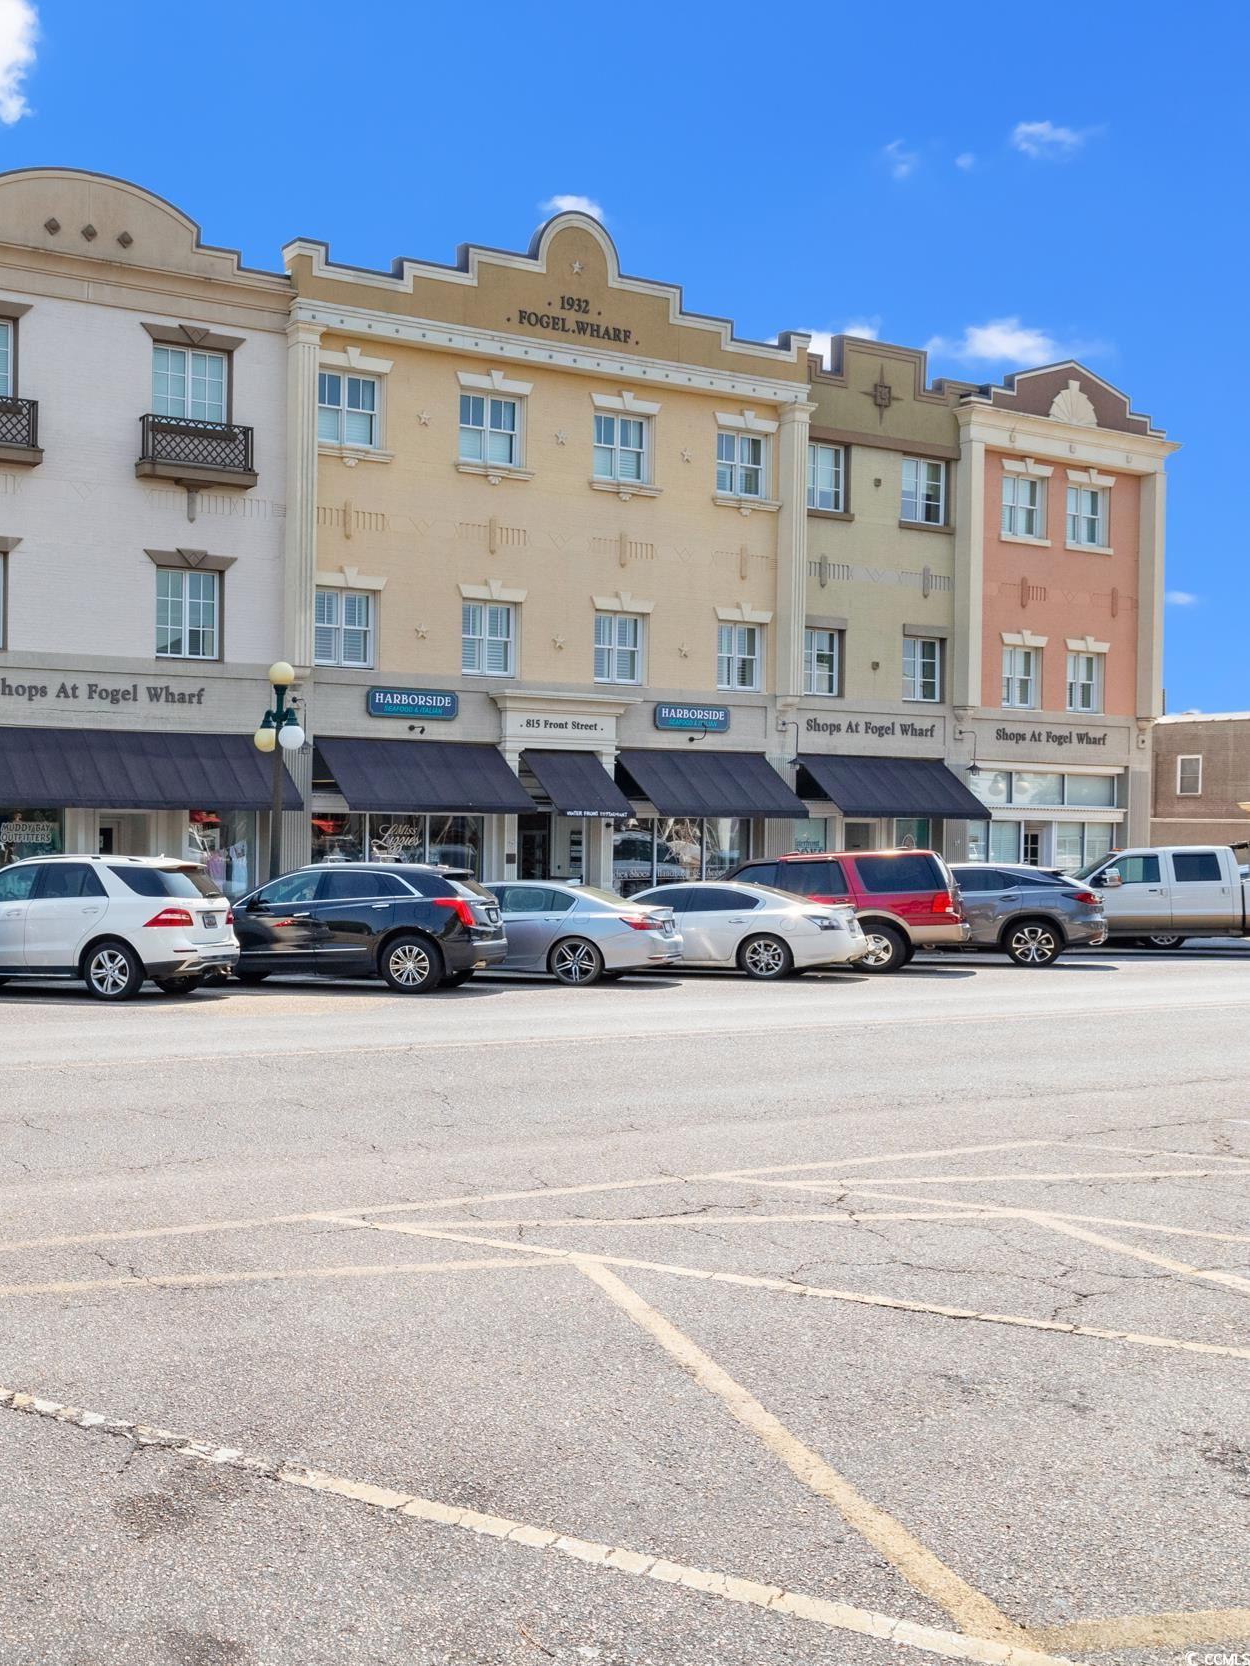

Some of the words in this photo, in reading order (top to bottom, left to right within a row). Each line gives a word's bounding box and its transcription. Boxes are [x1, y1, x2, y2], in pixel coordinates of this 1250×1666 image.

[560, 295, 590, 314] 1932
[55, 682, 79, 699] At
[87, 683, 138, 704] Fogel
[146, 686, 205, 705] Wharf
[375, 692, 452, 707] HARBORSIDE
[384, 705, 413, 713] SEAFOOD
[662, 708, 725, 720] HARBORSIDE
[525, 719, 540, 728] 815
[543, 720, 568, 729] Front
[571, 721, 597, 731] Street
[806, 717, 841, 735] Shops
[845, 720, 860, 733] At
[864, 721, 895, 737] Fogel
[899, 723, 935, 738] Wharf
[995, 727, 1027, 744] Shops
[1029, 730, 1043, 742] At
[1045, 731, 1072, 746] Fogel
[1076, 732, 1108, 746] Wharf
[0, 822, 31, 833] MUDDY
[0, 832, 51, 843] OUTFITTERS
